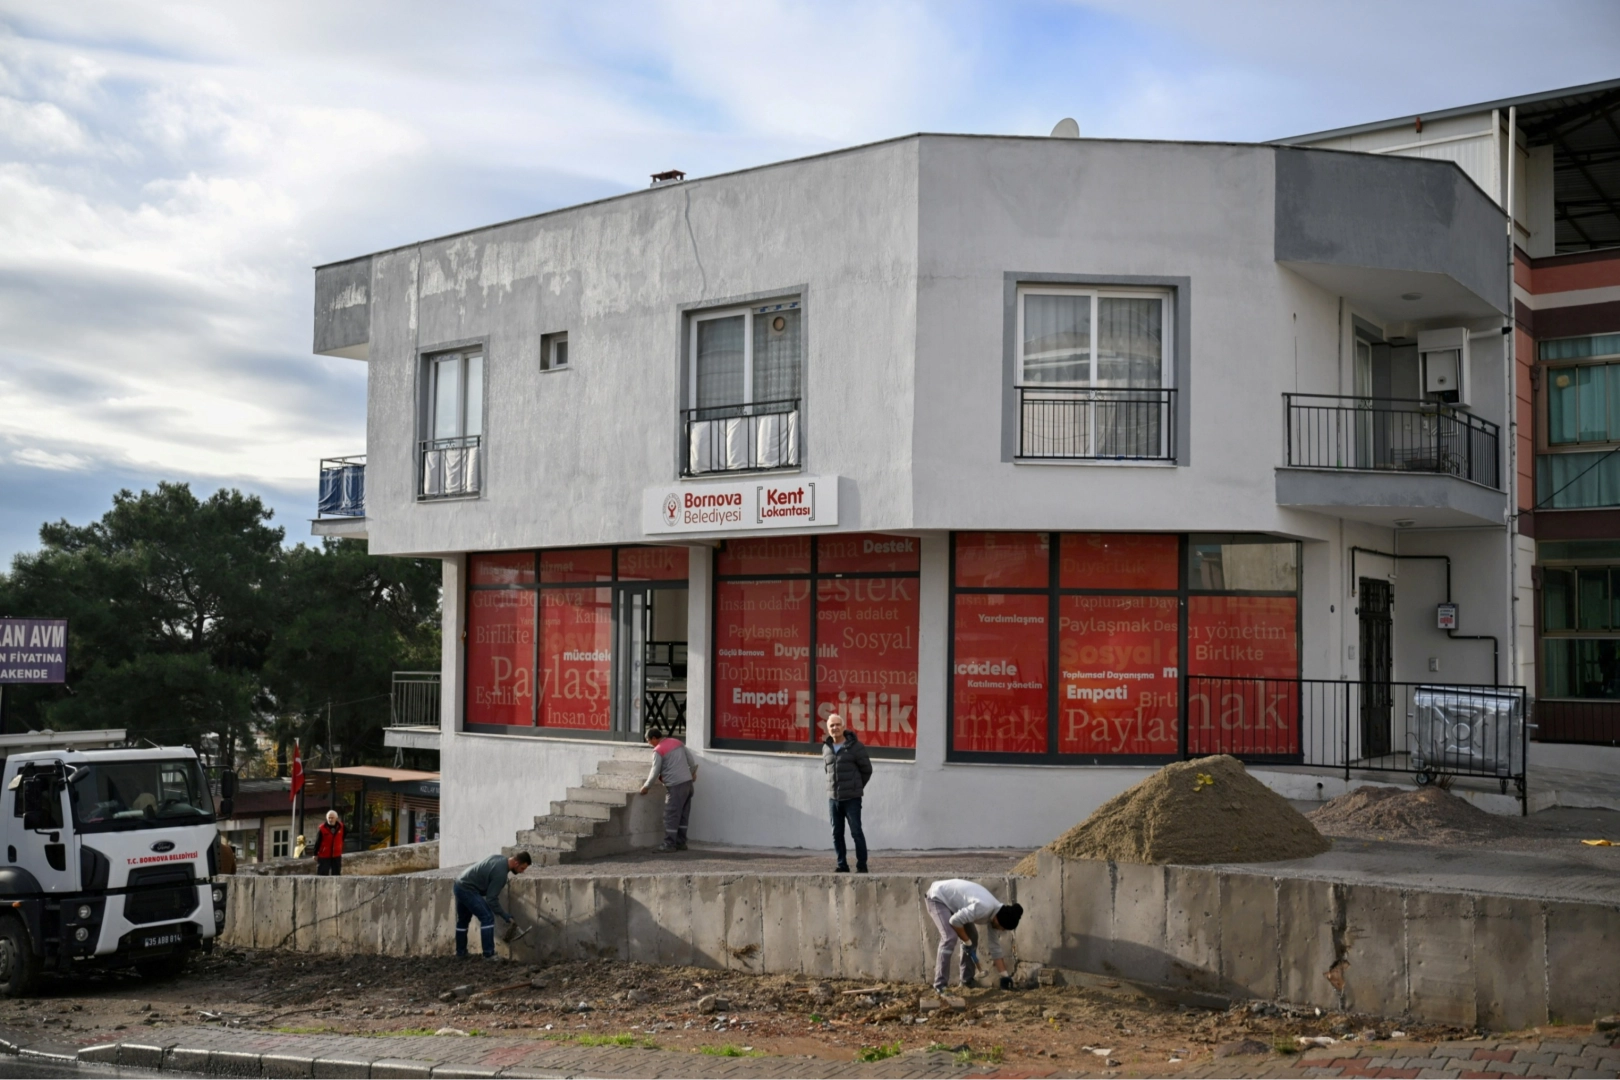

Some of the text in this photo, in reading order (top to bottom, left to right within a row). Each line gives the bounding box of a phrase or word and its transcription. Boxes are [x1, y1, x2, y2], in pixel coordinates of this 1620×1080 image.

[684, 492, 742, 508] Bornova
[767, 487, 804, 505] Kent
[684, 508, 742, 525] Belediyesi
[761, 506, 810, 518] Lokantası
[863, 539, 913, 554] Destek
[720, 594, 756, 611] İnsan
[856, 607, 899, 621] adalet
[977, 613, 1045, 626] Yardımlaşma
[475, 625, 530, 644] Birlikte
[729, 624, 799, 642] Paylaşmak
[1058, 616, 1151, 636] Paylaşmak
[1204, 620, 1288, 644] yönetim
[0, 624, 65, 647] AN AVM
[842, 625, 912, 655] Sosyal
[9, 651, 63, 663] FİYATINA
[1060, 637, 1161, 671] Sosyal
[1195, 645, 1264, 661] Birlikte
[719, 661, 918, 689] Toplumsal Dayanışma
[1062, 670, 1155, 682] Toplumsal Dayanışma
[967, 680, 1043, 690] Katılımcı yönetim
[732, 687, 789, 708] Empati
[1066, 684, 1128, 704] Empati
[546, 703, 587, 726] İnsan
[139, 855, 168, 864] BORNOVA
[169, 851, 198, 861] BELEDİYESİ
